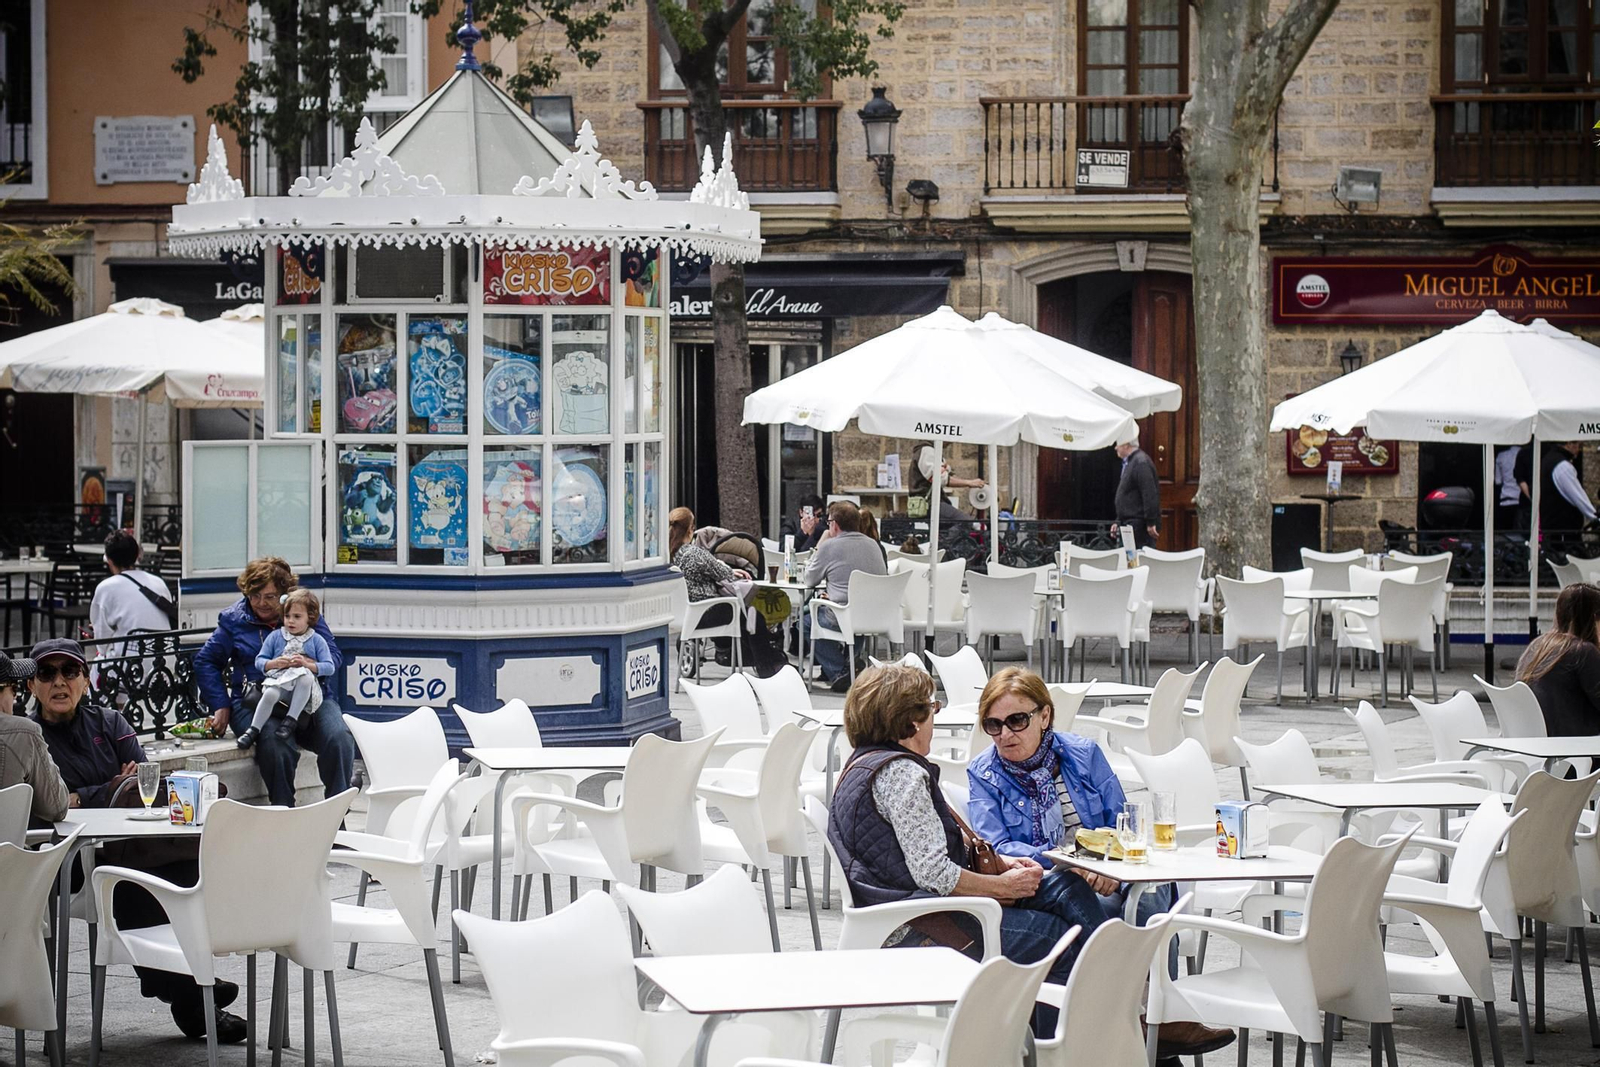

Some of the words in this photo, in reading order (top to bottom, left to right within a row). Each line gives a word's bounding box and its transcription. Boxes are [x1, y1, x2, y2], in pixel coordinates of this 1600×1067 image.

[1079, 152, 1092, 164] SE
[1094, 153, 1127, 165] VENDE
[504, 253, 569, 269] KIOSKO
[504, 267, 594, 294] CRISO
[1404, 273, 1505, 297] MIGUEL
[1513, 273, 1600, 297] ANGEL
[765, 295, 822, 315] Arana
[1435, 298, 1487, 310] CERVEZA
[1497, 299, 1525, 310] BEER
[1535, 299, 1569, 310] BIRRA
[217, 388, 258, 399] Cruzcampo
[914, 422, 963, 436] AMSTEL
[630, 653, 650, 669] KIOSKO
[359, 663, 421, 677] KIOSKO
[629, 665, 657, 691] CRISO
[359, 677, 447, 701] CRISO
